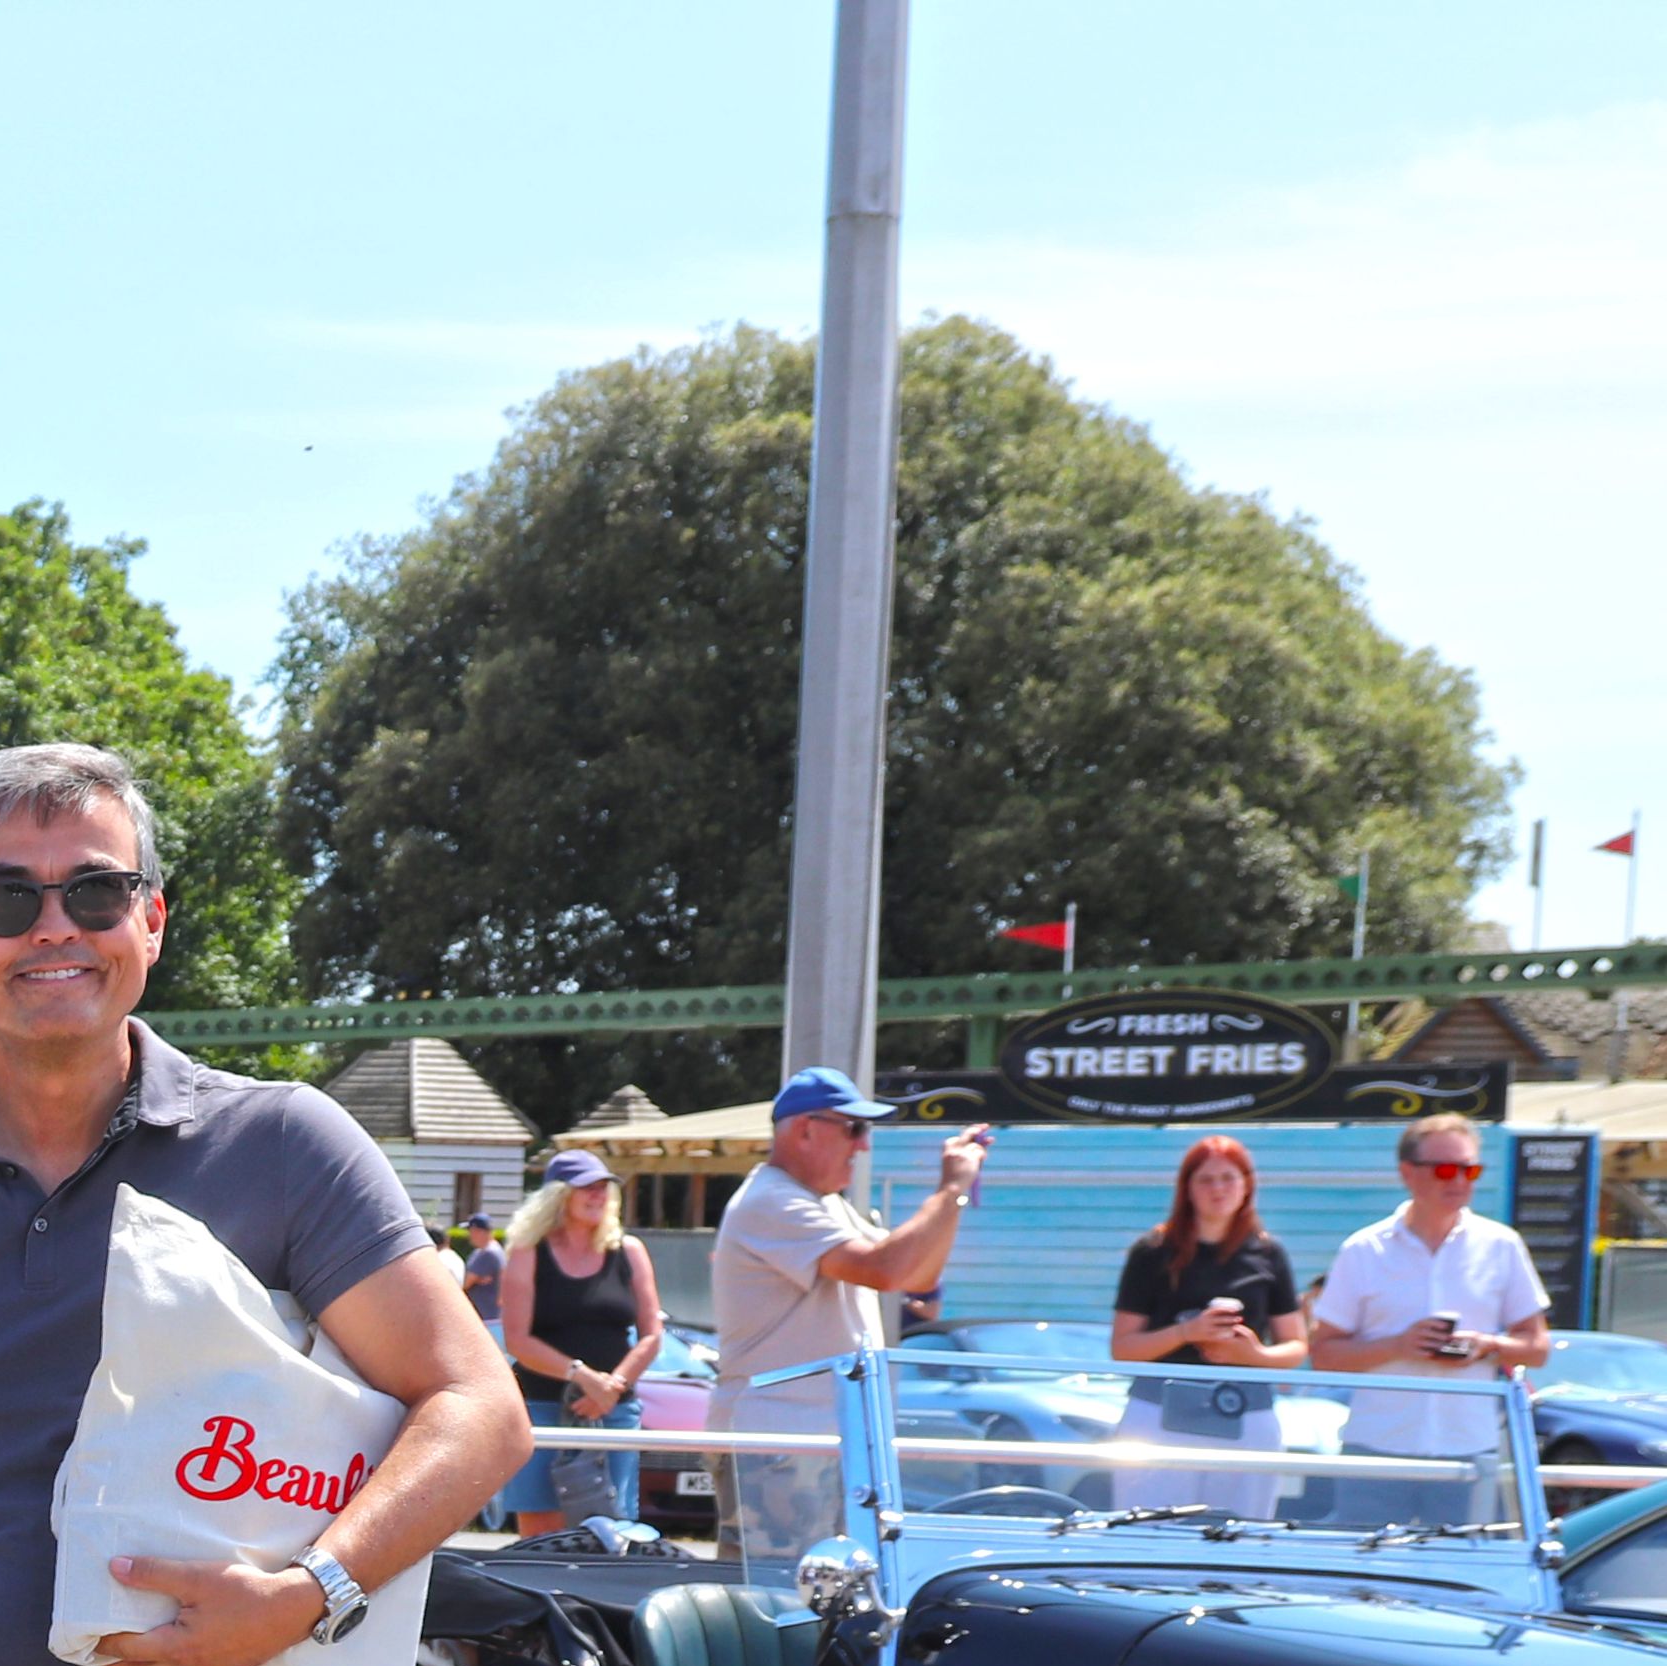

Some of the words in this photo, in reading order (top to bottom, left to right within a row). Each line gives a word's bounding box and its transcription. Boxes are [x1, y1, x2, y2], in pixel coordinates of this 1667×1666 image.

[1118, 1013, 1210, 1037] FRESH
[1023, 1046, 1175, 1079] STREET
[1184, 1041, 1308, 1076] FRIES
